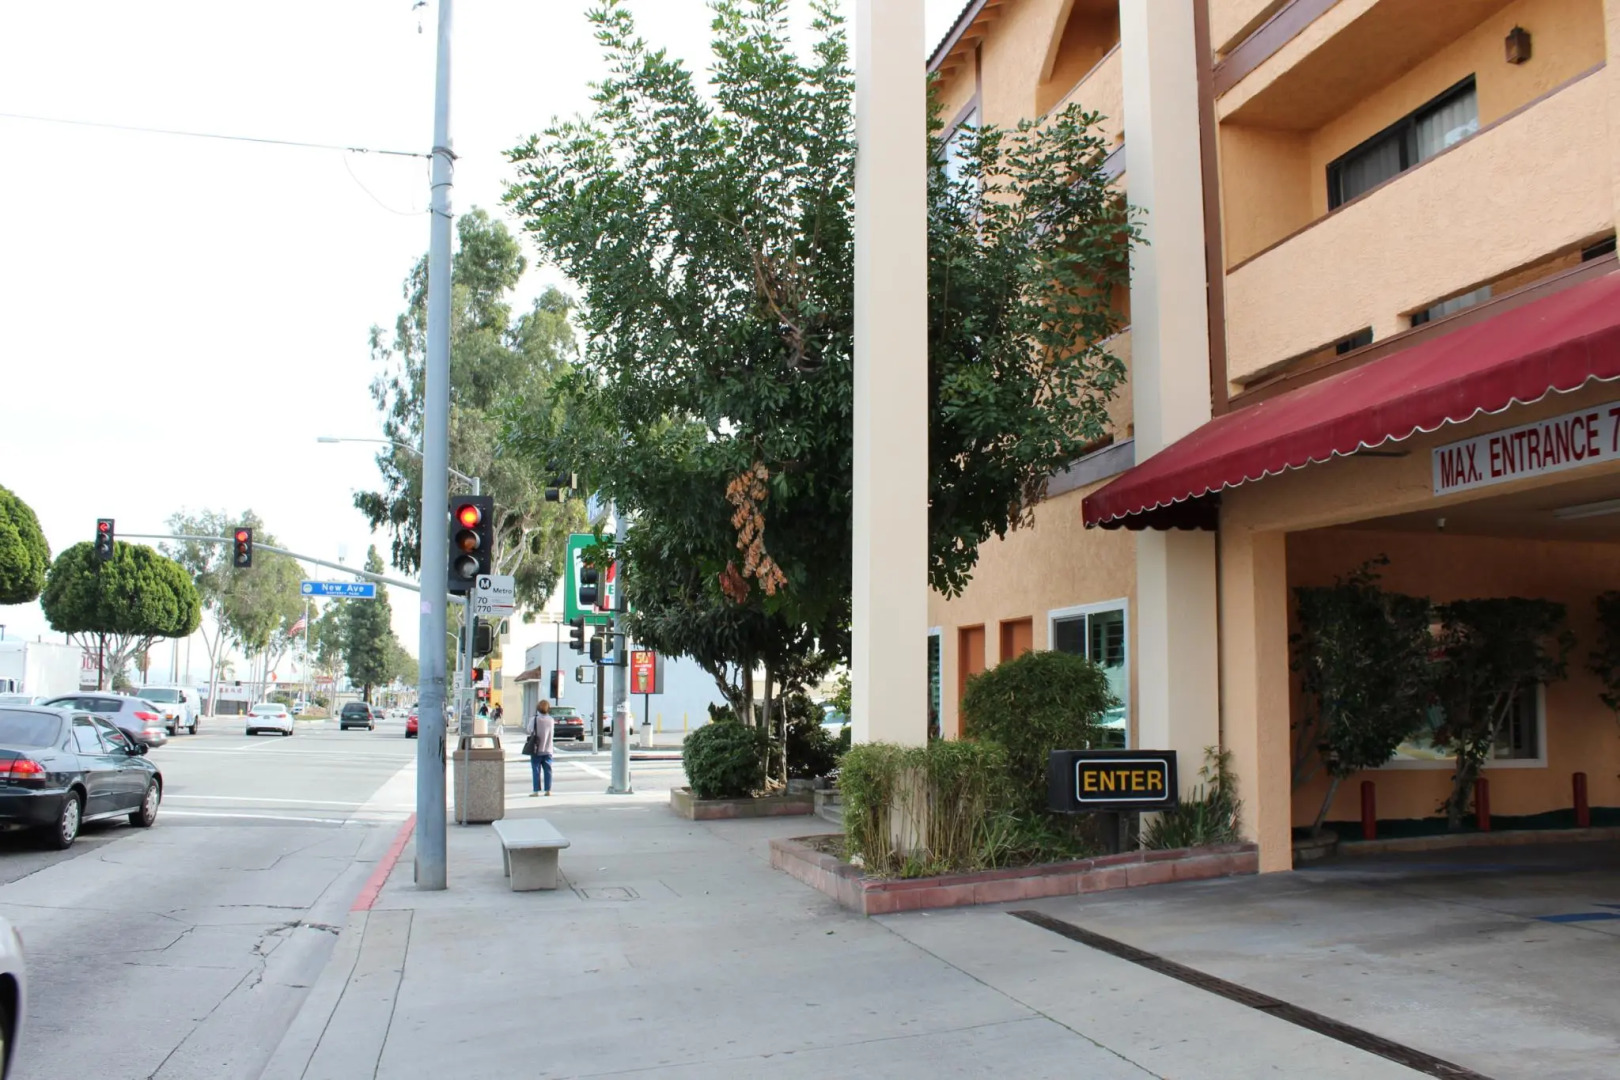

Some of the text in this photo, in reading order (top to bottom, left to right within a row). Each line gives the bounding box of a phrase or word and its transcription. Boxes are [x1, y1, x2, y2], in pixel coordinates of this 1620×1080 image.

[1440, 443, 1483, 489] MAX.
[1489, 413, 1601, 478] ENTRANCE
[322, 583, 364, 593] New Ave
[477, 596, 488, 605] 70
[1083, 769, 1163, 792] ENTER
